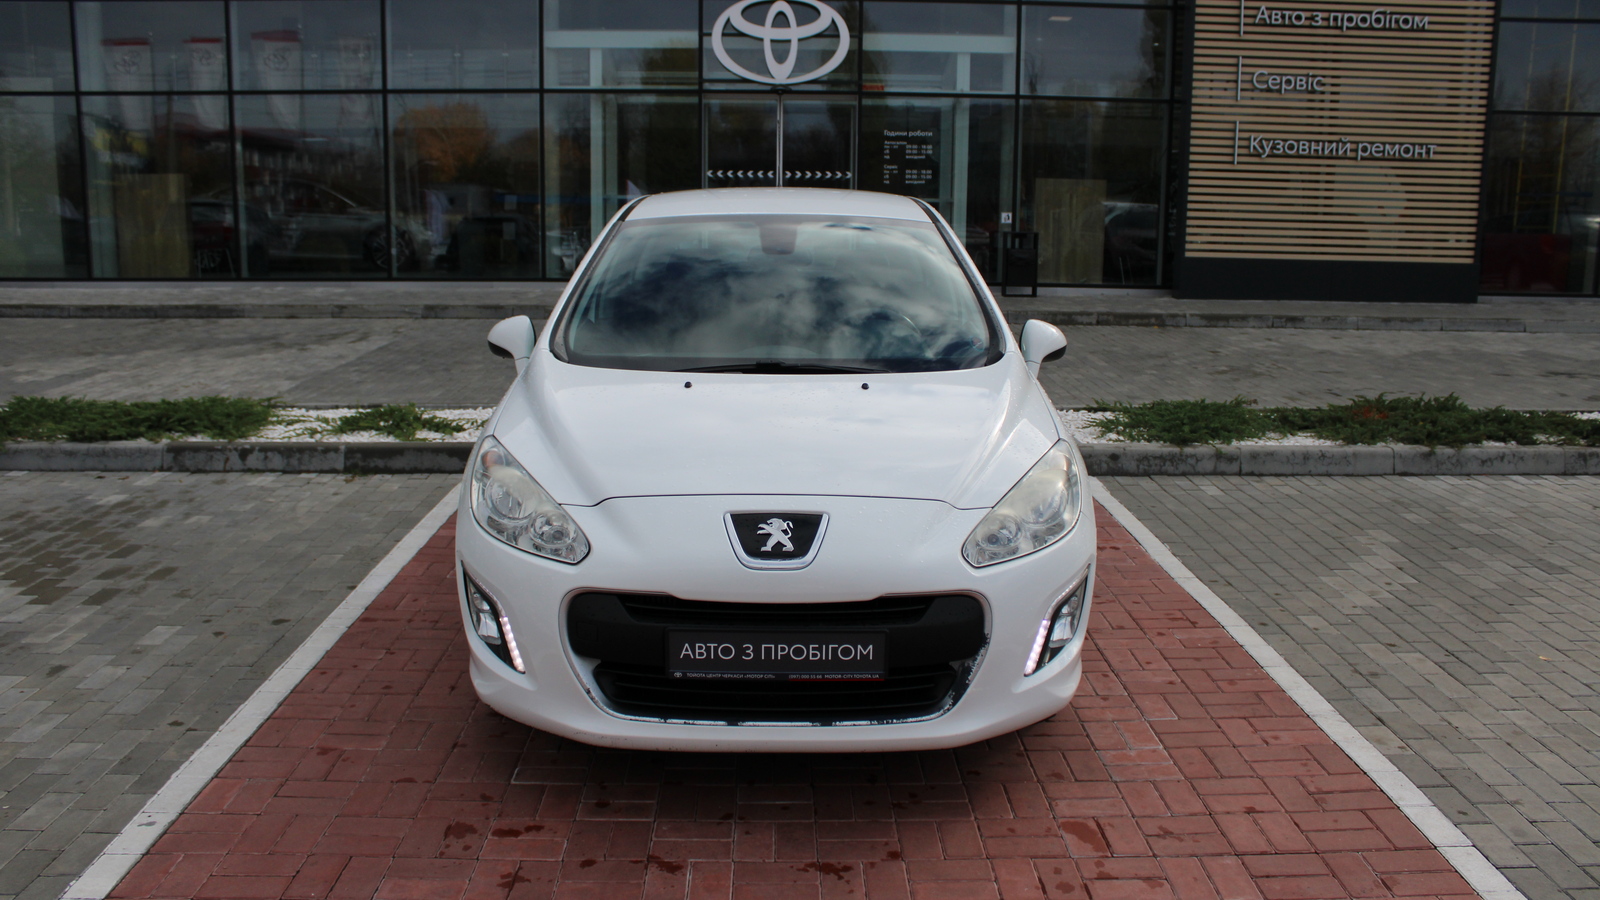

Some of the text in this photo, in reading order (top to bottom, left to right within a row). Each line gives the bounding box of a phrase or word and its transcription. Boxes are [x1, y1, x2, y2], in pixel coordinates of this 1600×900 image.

[1255, 5, 1429, 32] Авто з пробігом
[1252, 70, 1325, 94] Сервіс
[1250, 135, 1437, 161] Кузовний ремонт
[680, 643, 873, 661] АВТО З ПРОБІГОМ
